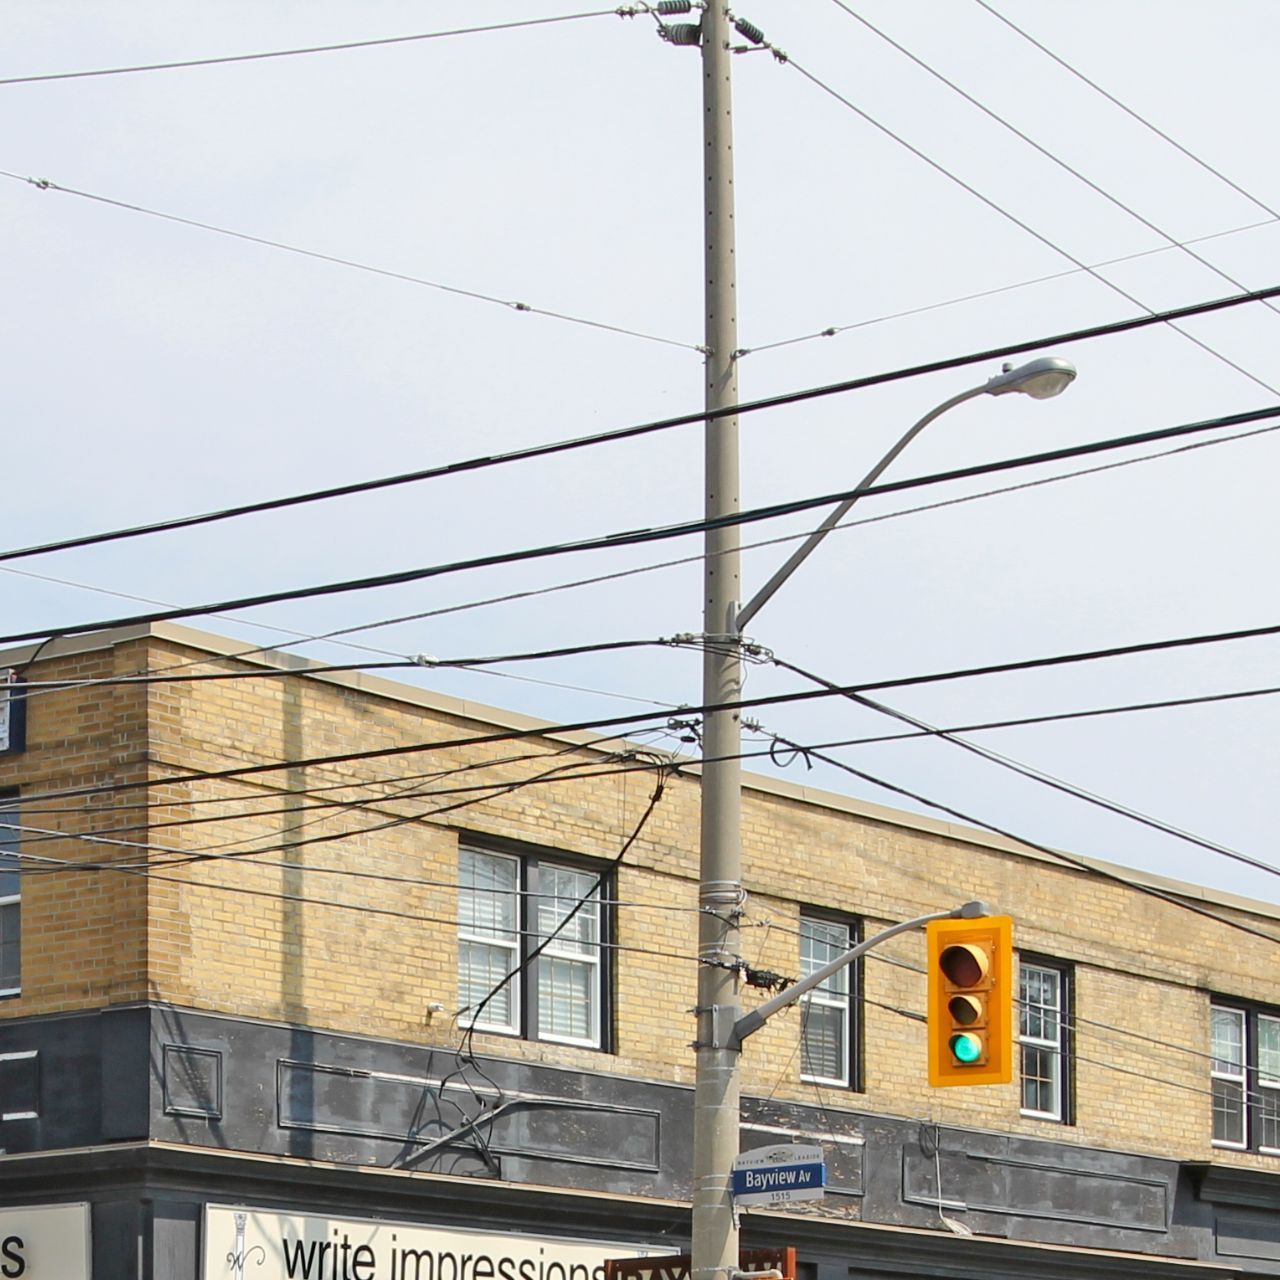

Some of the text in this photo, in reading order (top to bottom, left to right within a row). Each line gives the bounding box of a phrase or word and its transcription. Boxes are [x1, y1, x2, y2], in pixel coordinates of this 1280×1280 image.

[745, 1168, 812, 1190] Bayview Av
[770, 1191, 792, 1201] 1515
